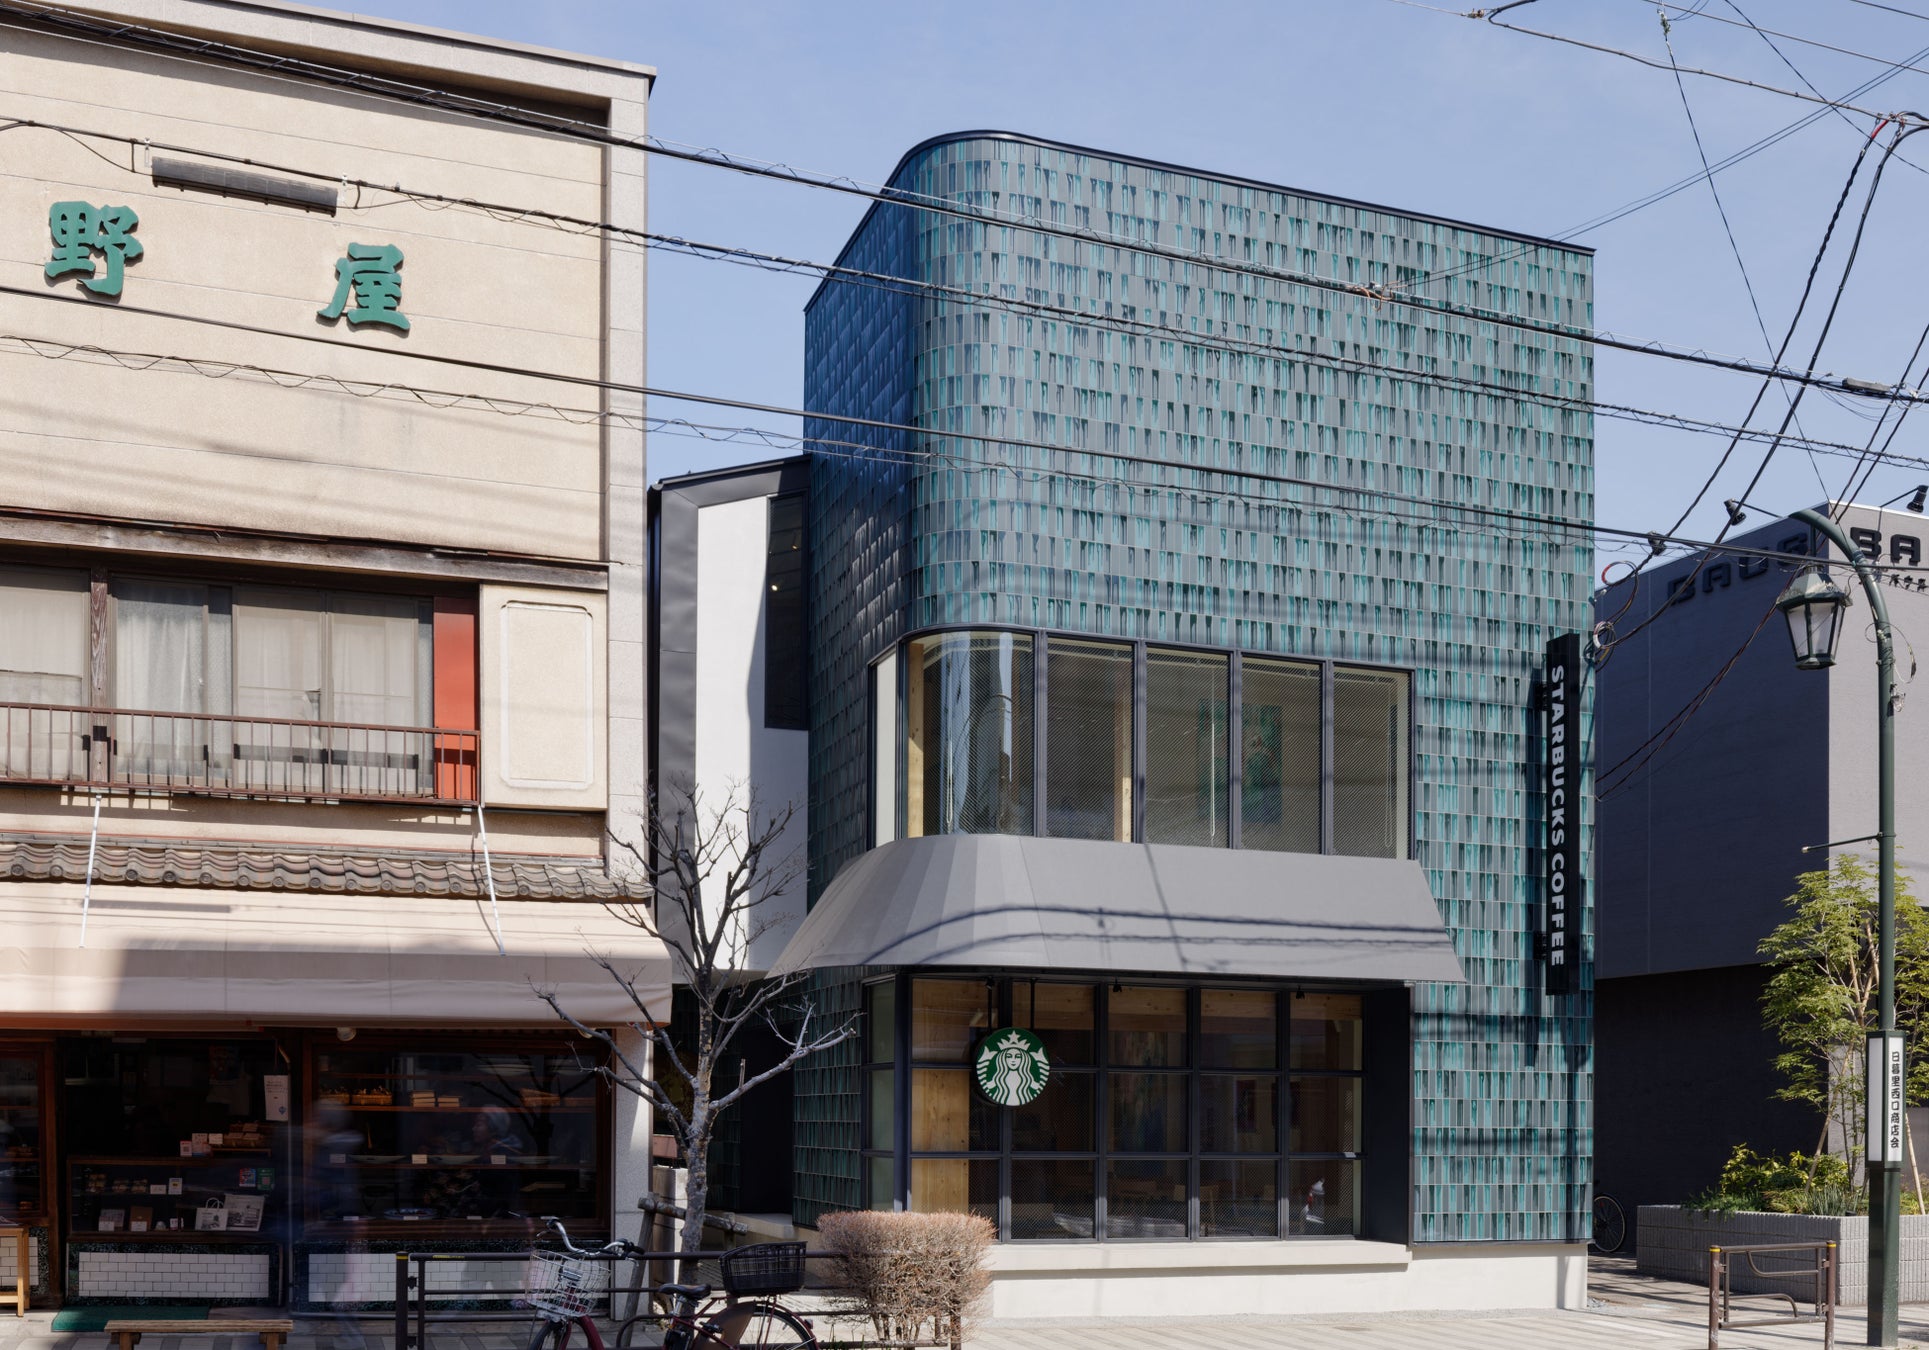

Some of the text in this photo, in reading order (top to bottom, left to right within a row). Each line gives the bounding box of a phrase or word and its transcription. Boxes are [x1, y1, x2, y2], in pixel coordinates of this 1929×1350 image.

[1551, 665, 1565, 966] STARBUCKS COFFEE
[1891, 1051, 1900, 1149] 日暮里西口商店会
